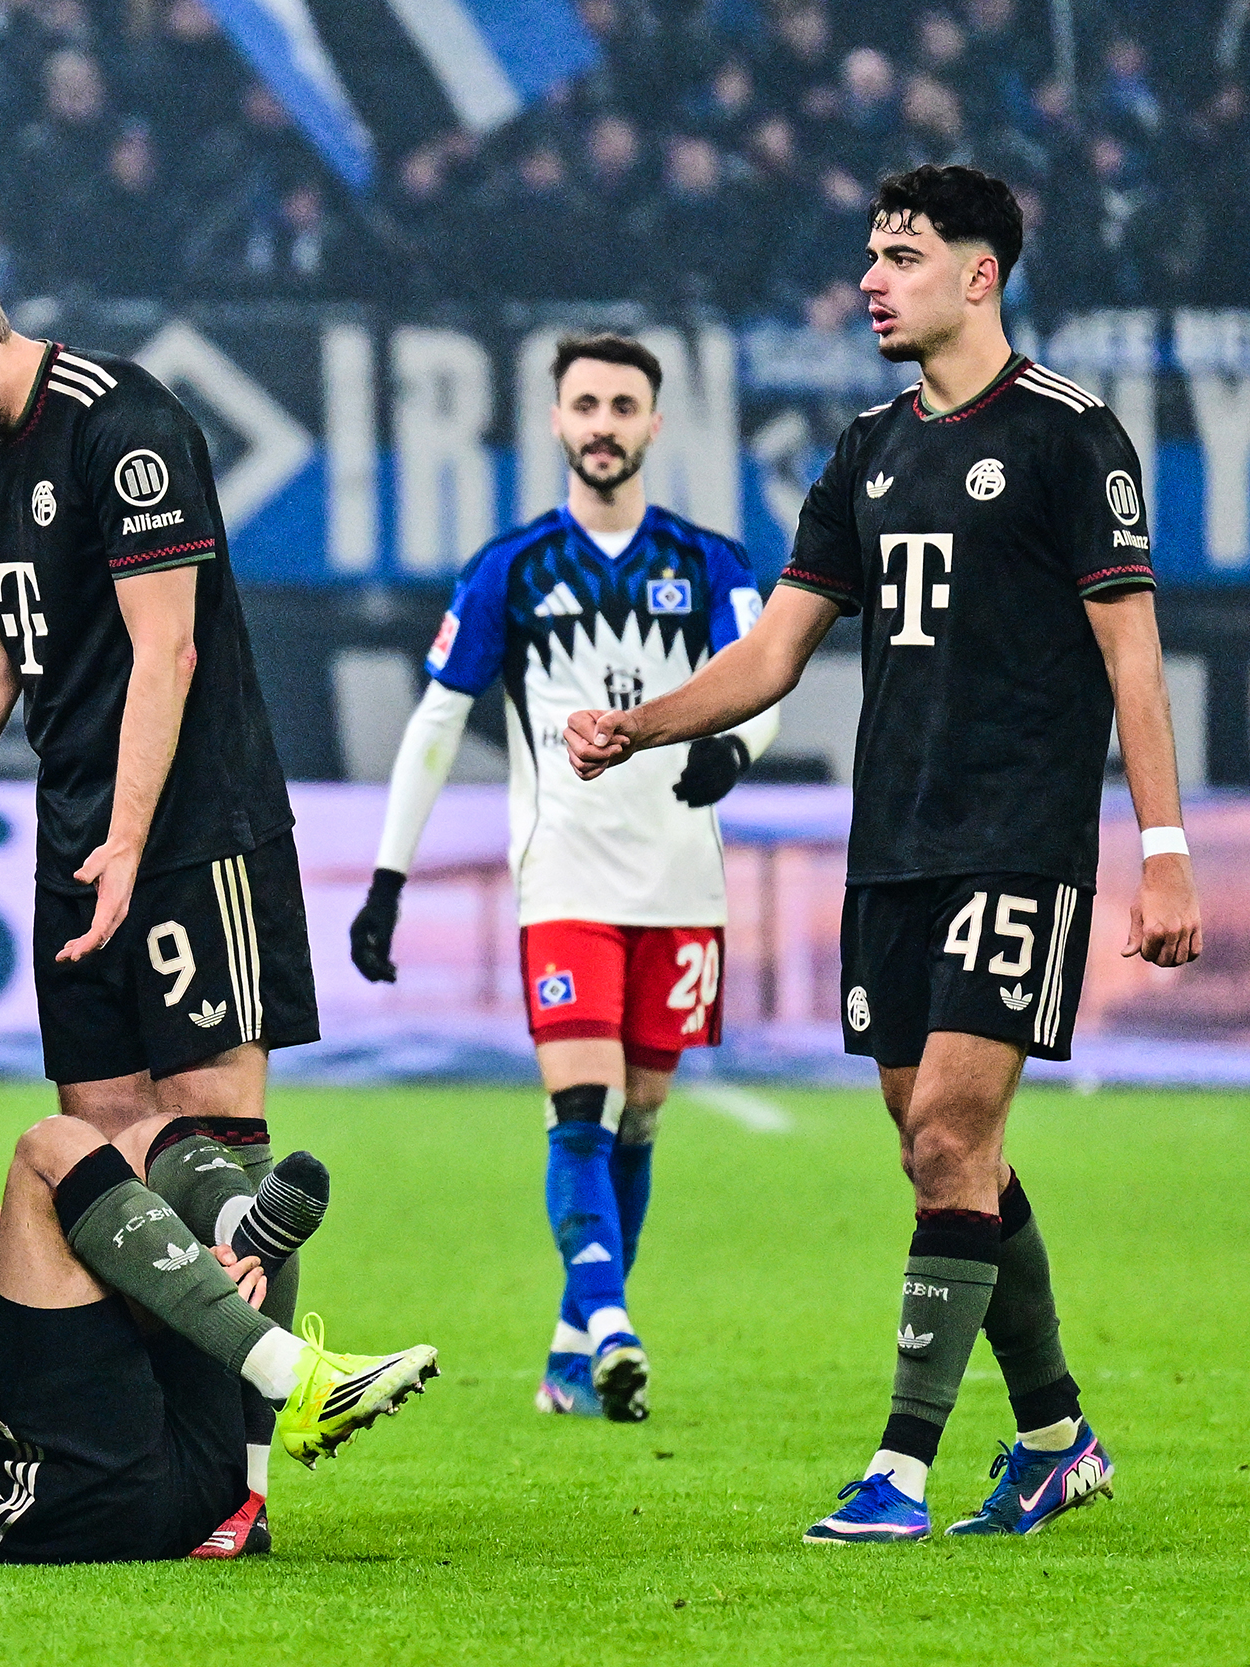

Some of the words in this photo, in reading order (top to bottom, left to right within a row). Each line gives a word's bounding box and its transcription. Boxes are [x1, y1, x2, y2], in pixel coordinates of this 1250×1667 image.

[121, 509, 185, 536] Allianz
[1112, 529, 1149, 550] Allianz
[943, 891, 1038, 977] 45
[146, 920, 197, 1008] 9
[666, 938, 720, 1010] 20
[902, 1281, 949, 1302] CBM
